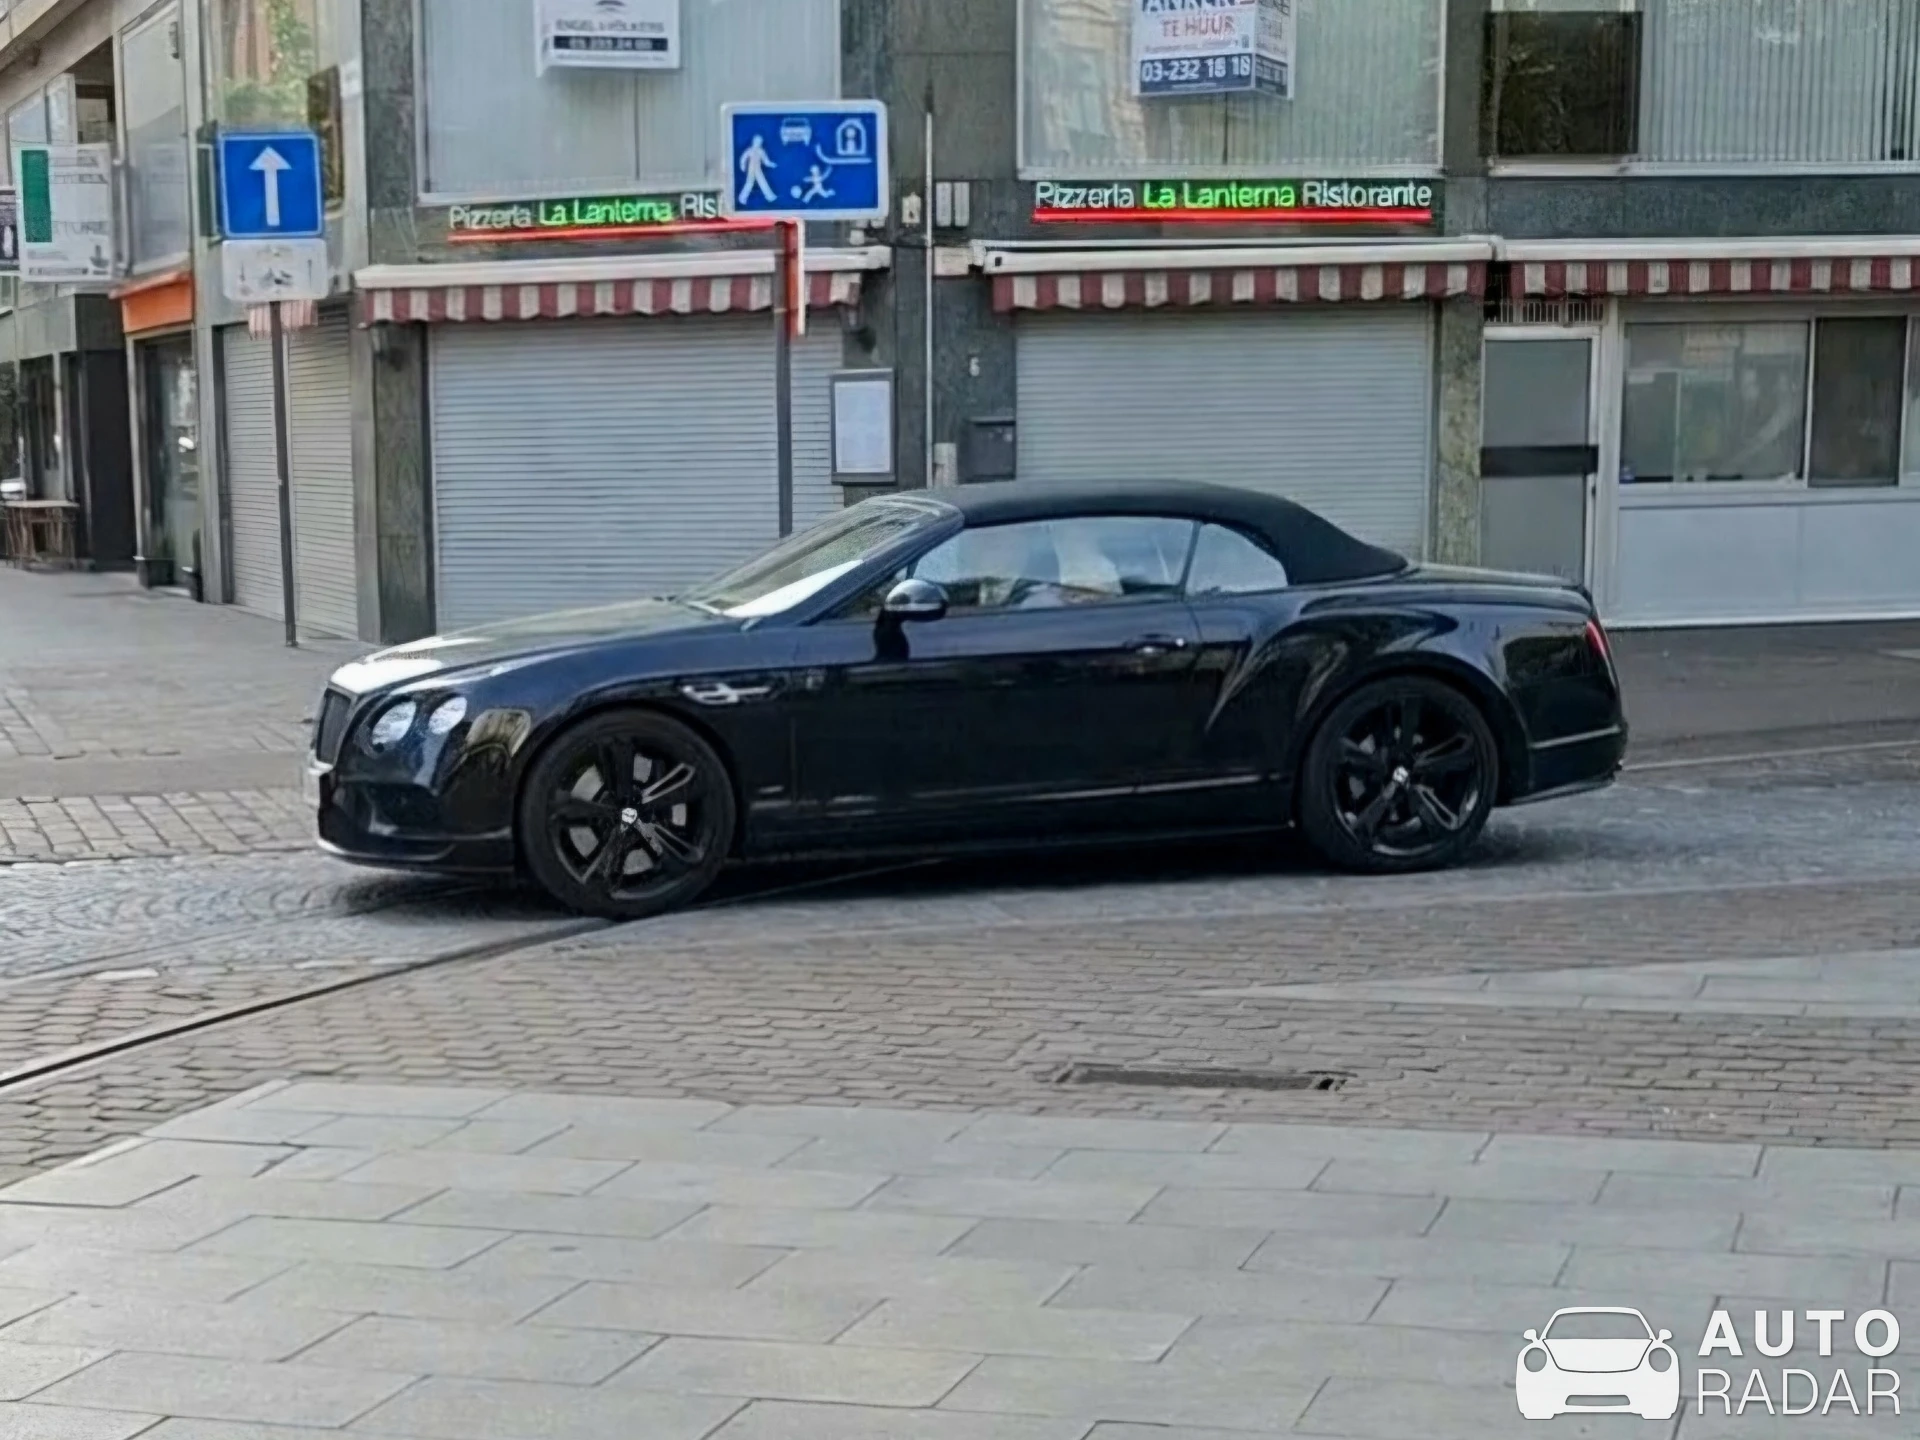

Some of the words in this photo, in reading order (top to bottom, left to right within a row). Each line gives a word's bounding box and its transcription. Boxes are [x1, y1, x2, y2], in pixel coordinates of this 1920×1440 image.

[1142, 58, 1201, 83] 03-232
[1035, 181, 1135, 209] Pizzeria
[1143, 182, 1176, 209] La
[1183, 181, 1295, 208] Lanterna
[1302, 180, 1433, 207] Ristorante
[449, 204, 532, 229] Pizzeria
[539, 200, 568, 226] La
[574, 196, 673, 224] Lanterna
